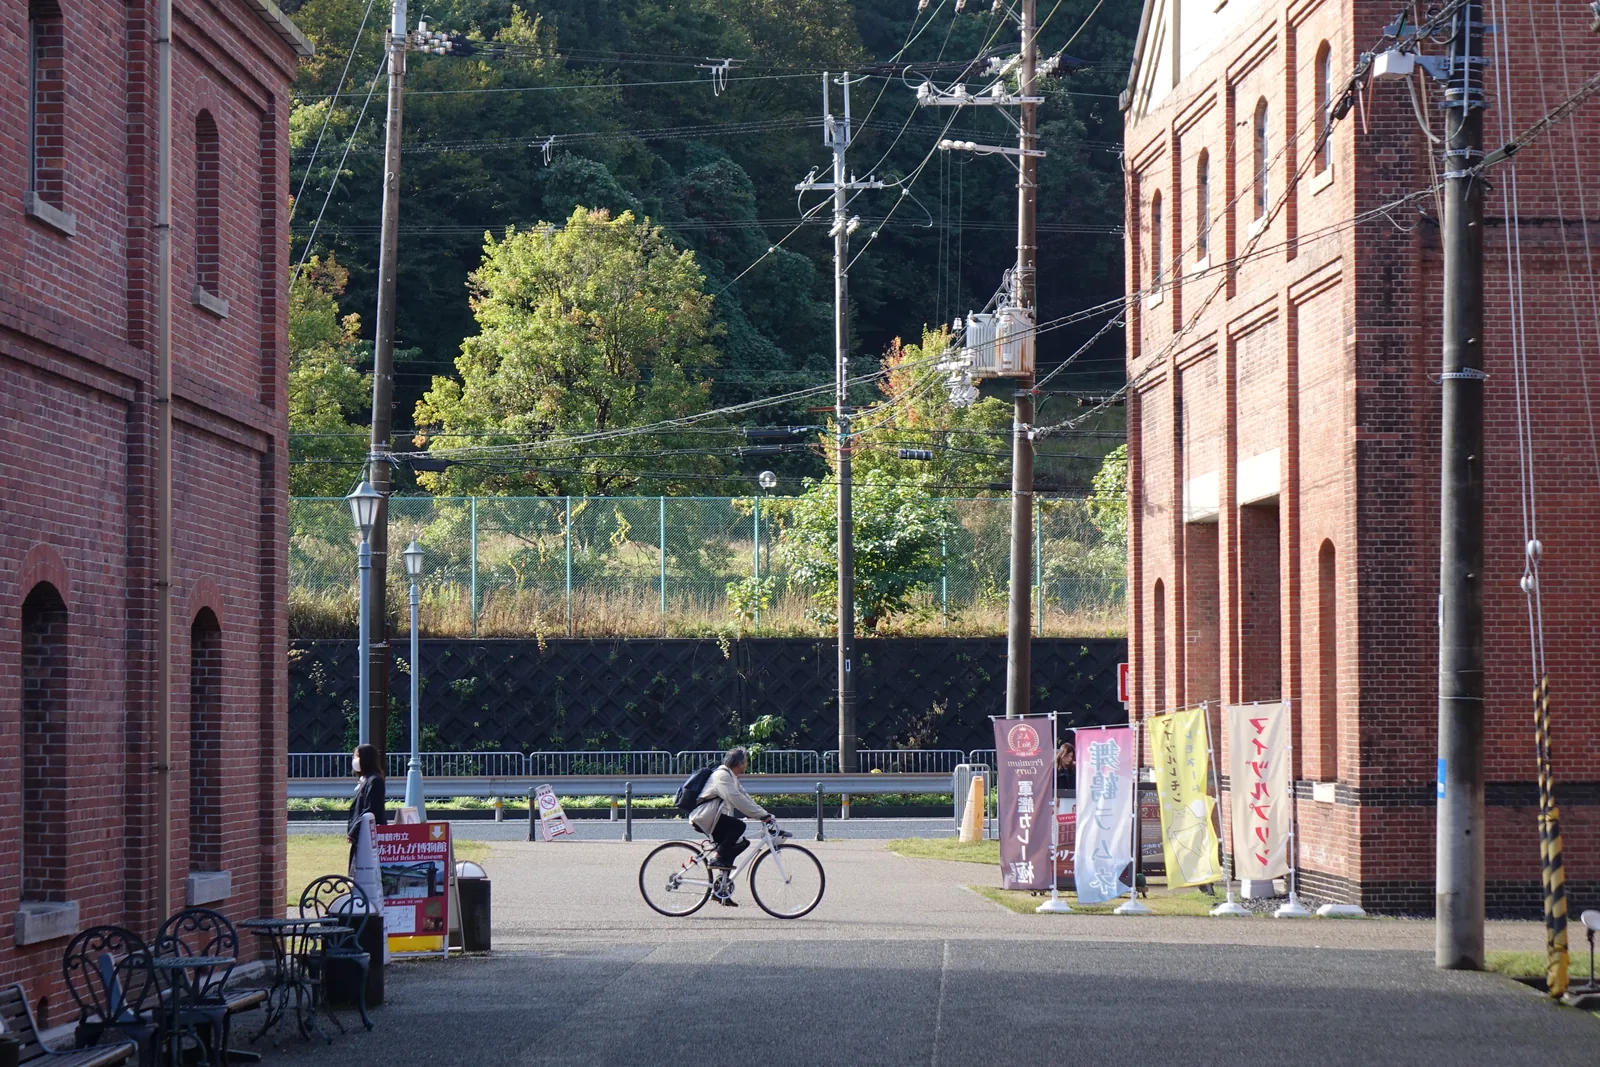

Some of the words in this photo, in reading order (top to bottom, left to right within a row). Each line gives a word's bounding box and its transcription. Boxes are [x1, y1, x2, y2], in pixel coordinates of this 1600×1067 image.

[378, 841, 447, 856] 赤れんが博物館
